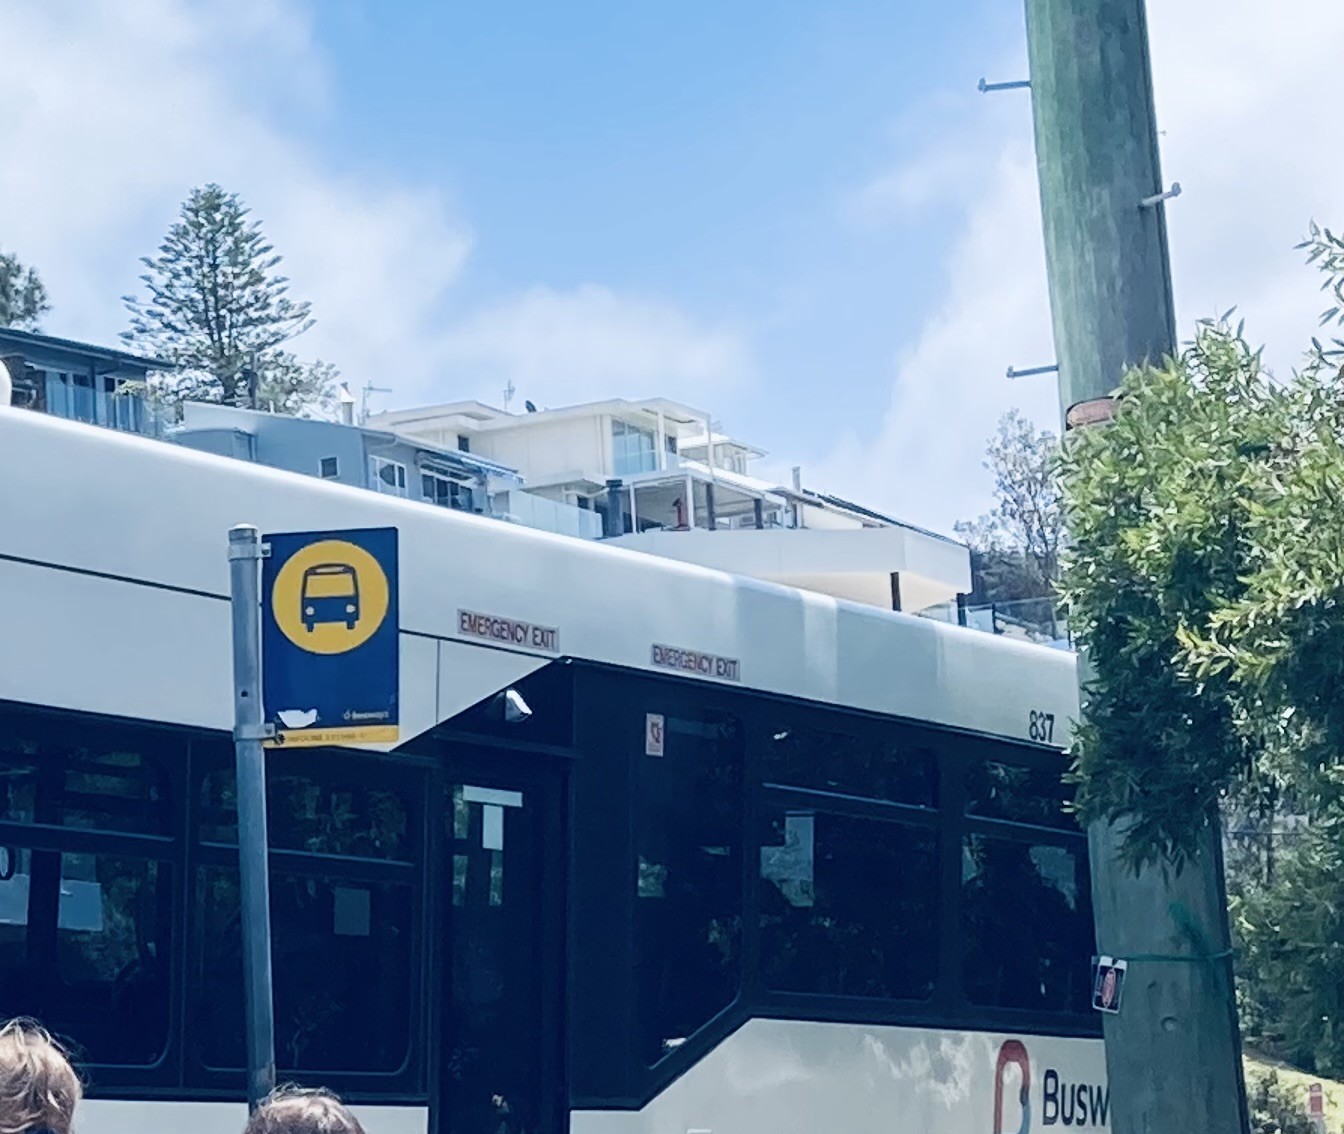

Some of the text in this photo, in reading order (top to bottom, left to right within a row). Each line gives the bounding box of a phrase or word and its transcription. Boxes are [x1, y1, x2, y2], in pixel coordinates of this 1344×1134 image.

[460, 611, 557, 650] EMERGENCY EXIT
[653, 645, 739, 680] EMERGENCY EXIT
[1029, 709, 1055, 743] 837
